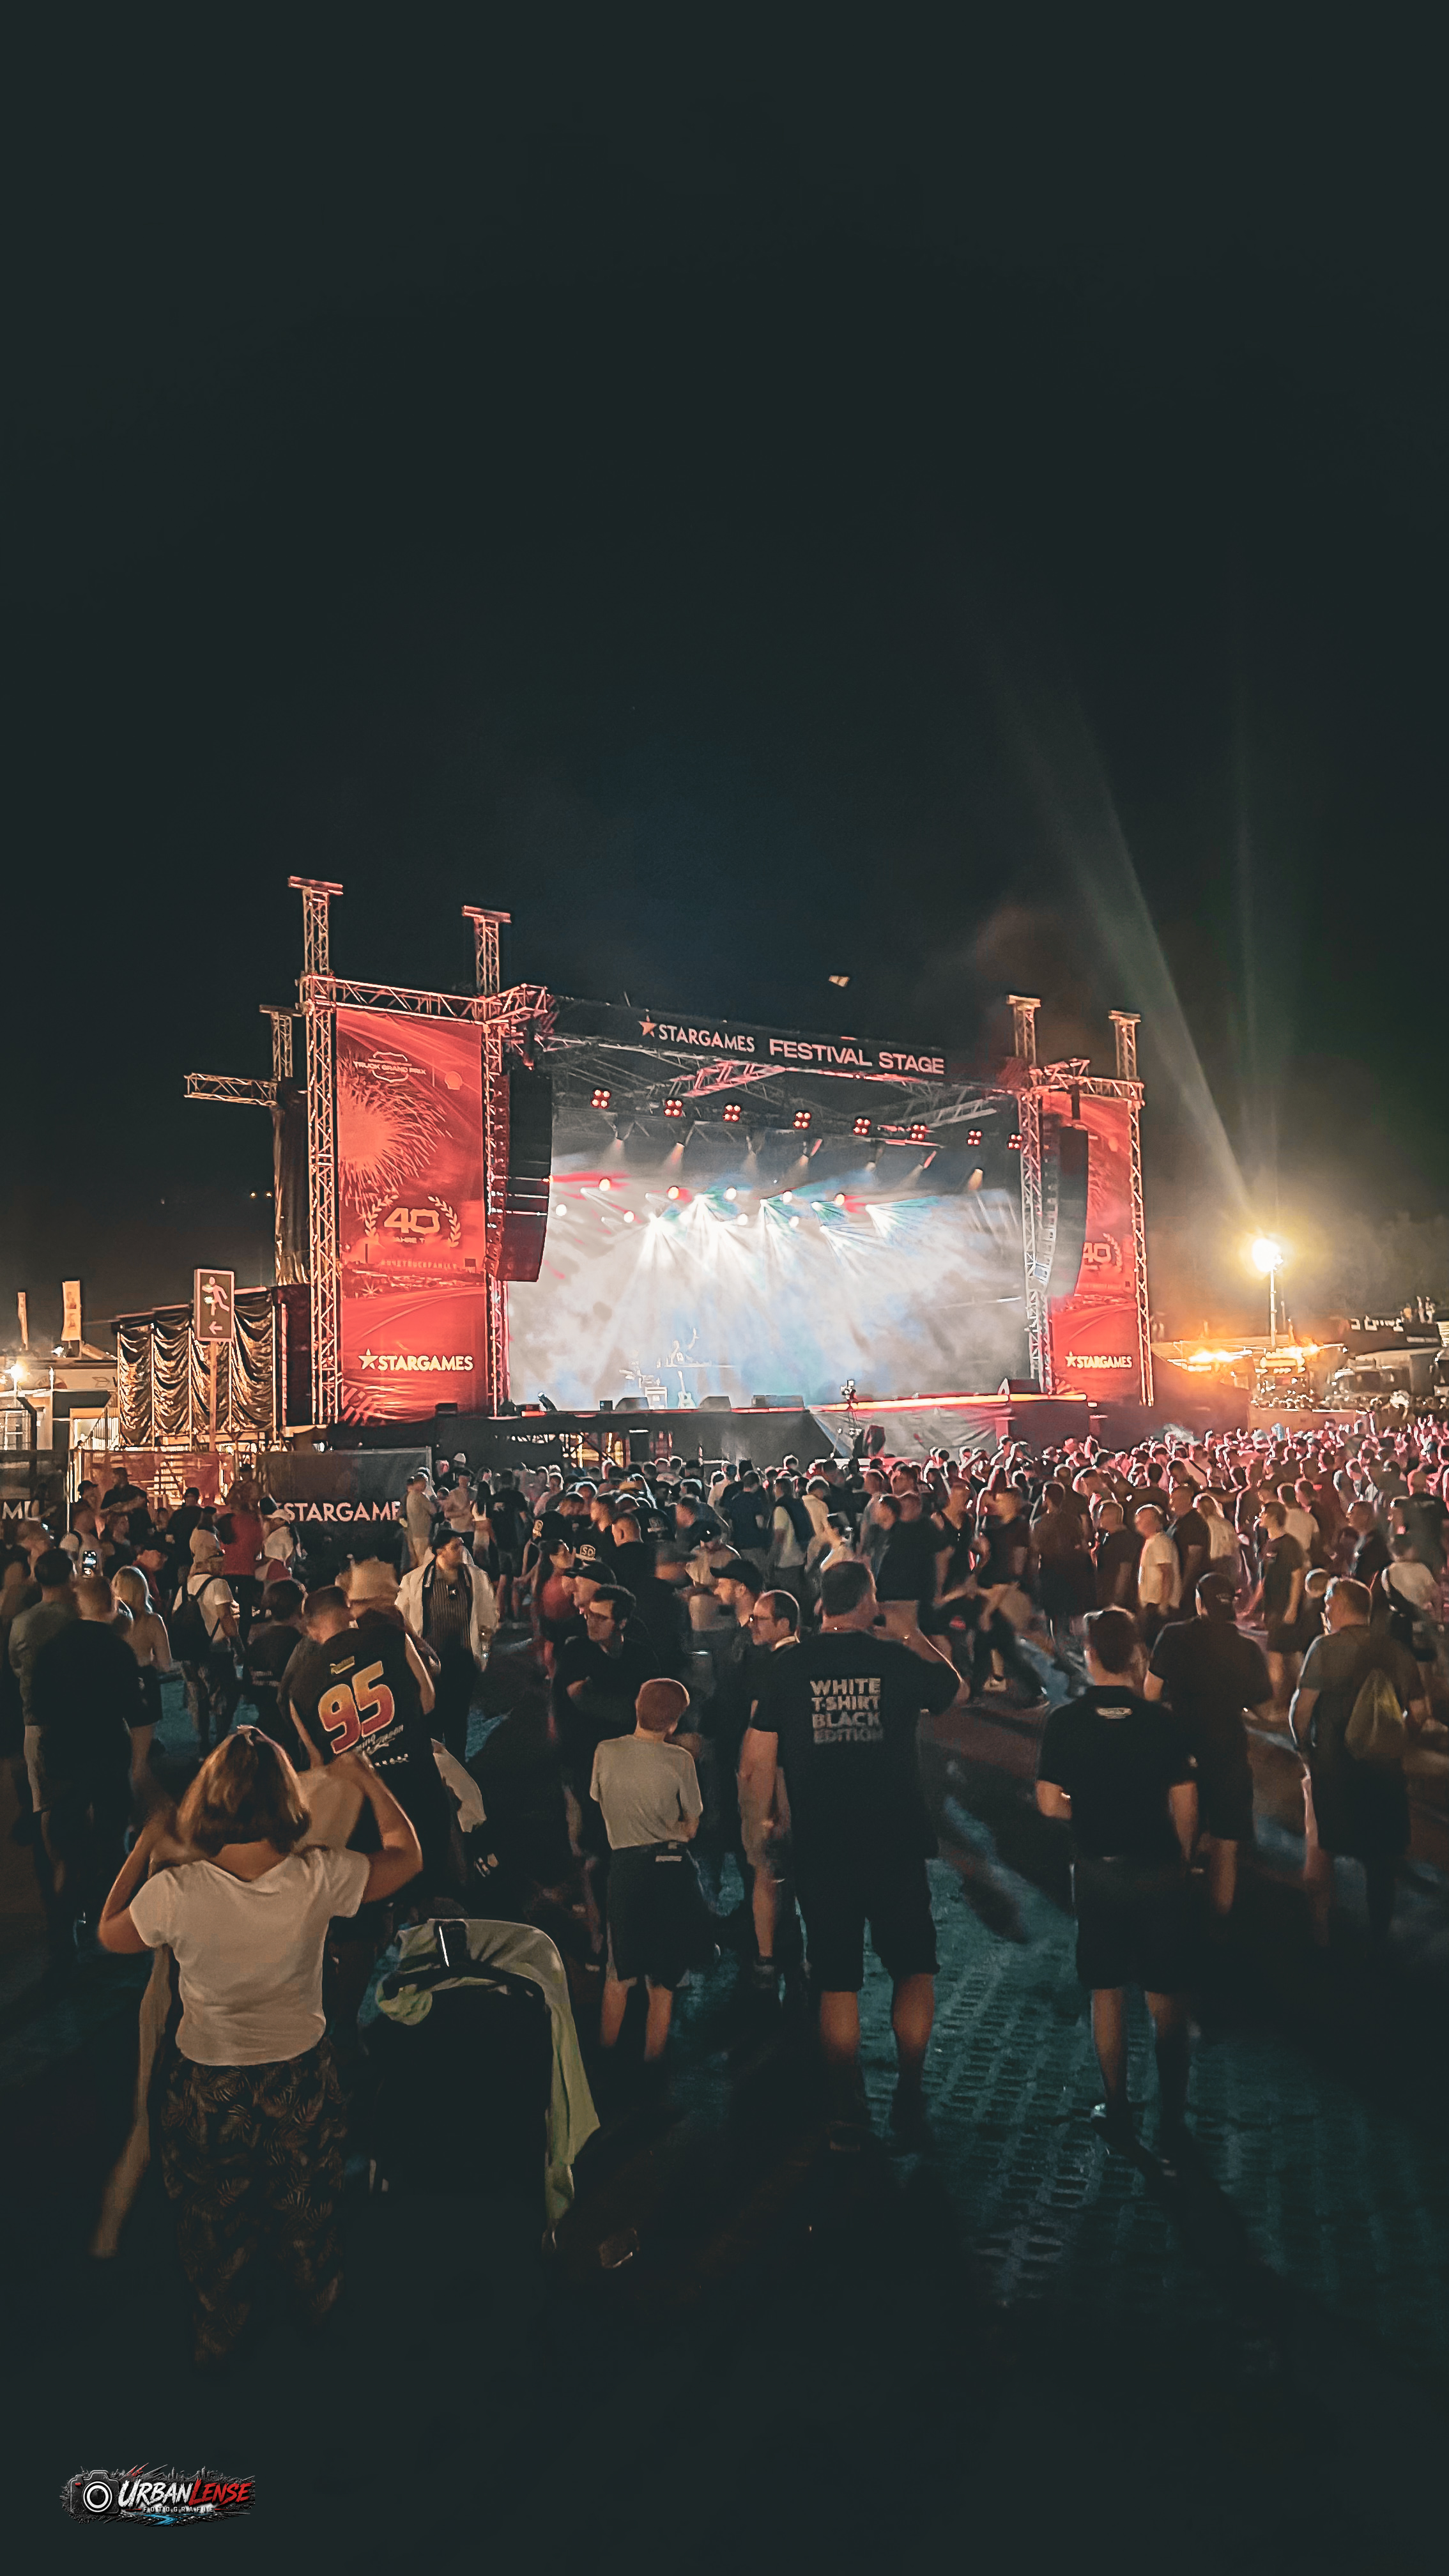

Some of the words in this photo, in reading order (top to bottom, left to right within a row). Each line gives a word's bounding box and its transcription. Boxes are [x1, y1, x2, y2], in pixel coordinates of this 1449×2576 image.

[659, 1023, 755, 1052] STARGAMES
[769, 1038, 873, 1067] FESTIVAL
[878, 1052, 944, 1075] STAGE
[384, 1208, 440, 1235] 40
[378, 1355, 473, 1371] STARGAMES
[1077, 1355, 1133, 1368] STARGAMES
[810, 1678, 880, 1696] WHITE
[318, 1660, 395, 1754] 95
[812, 1712, 880, 1728] BLACK
[814, 1726, 883, 1743] EDITION
